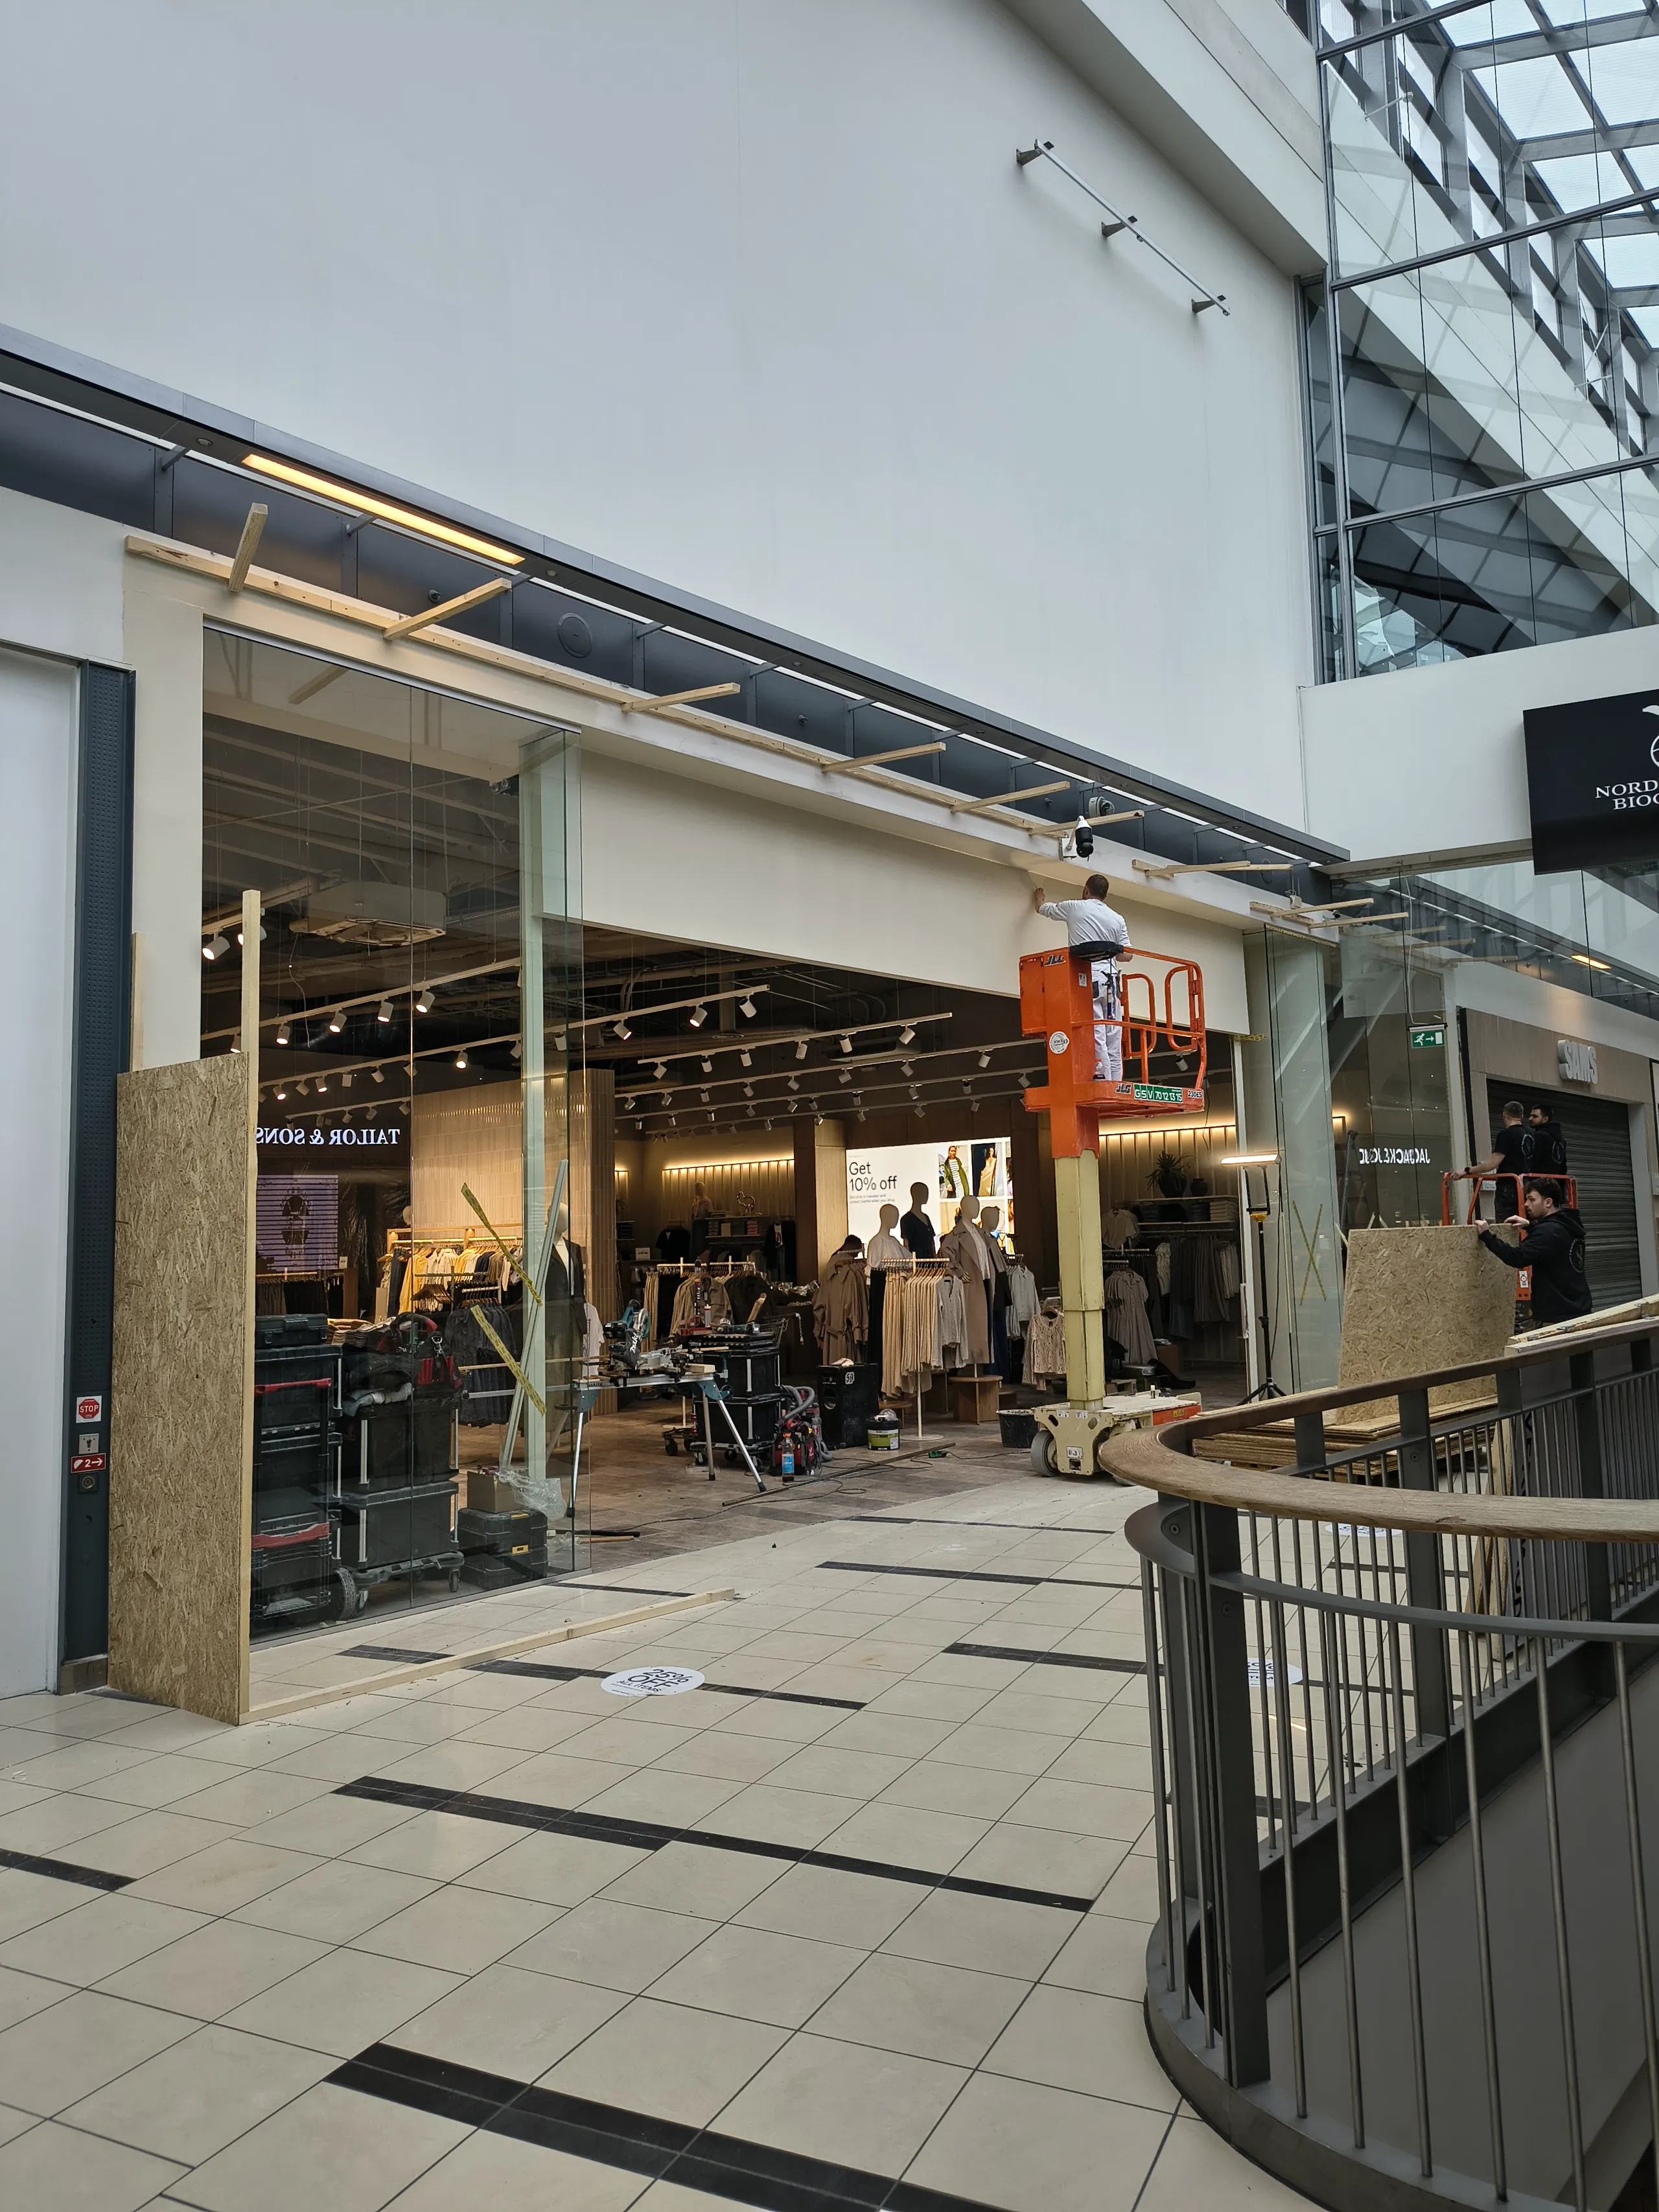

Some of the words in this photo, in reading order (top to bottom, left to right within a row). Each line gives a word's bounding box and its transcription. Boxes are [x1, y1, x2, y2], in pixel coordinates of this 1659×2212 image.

[849, 1161, 872, 1175] Get
[849, 1177, 877, 1191] 10%
[879, 1175, 898, 1190] off
[79, 1404, 99, 1413] STOP
[84, 1459, 91, 1467] 2
[627, 1675, 679, 1687] OFF
[643, 1669, 693, 1683] 25%
